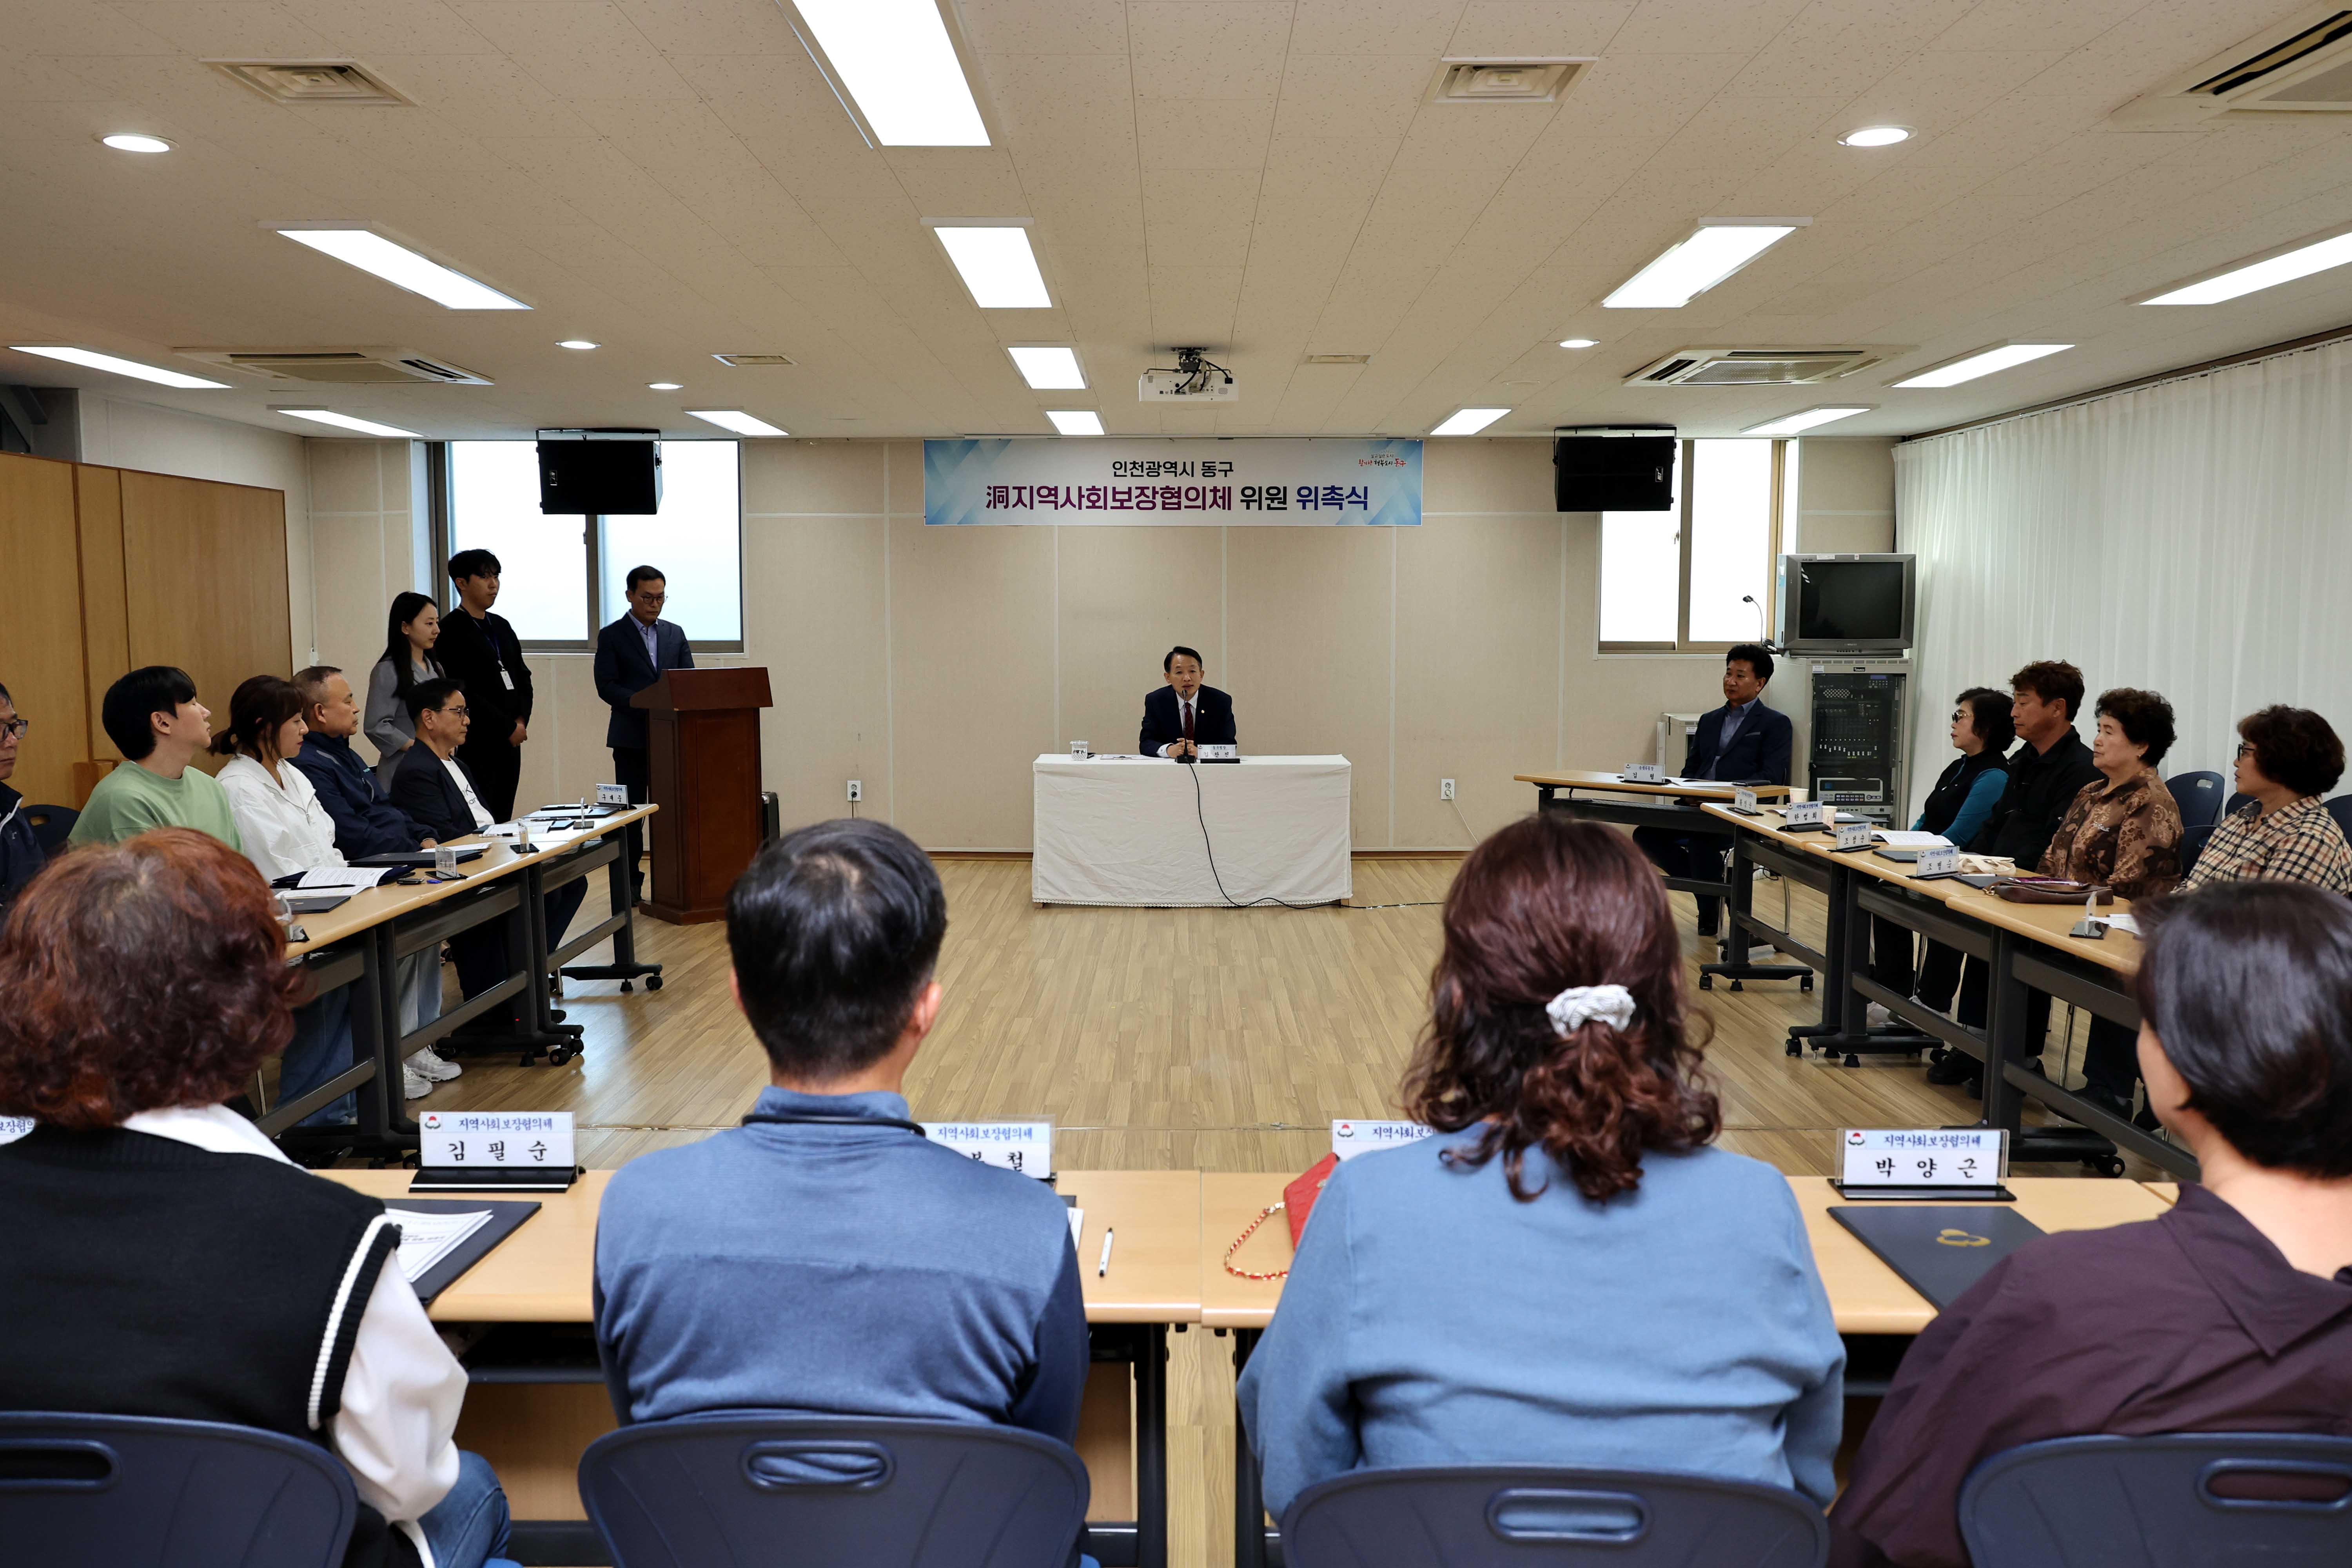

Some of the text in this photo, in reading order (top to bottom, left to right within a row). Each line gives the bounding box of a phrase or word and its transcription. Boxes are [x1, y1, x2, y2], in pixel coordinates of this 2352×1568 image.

[1112, 461, 1234, 477] 인천광역시 동구
[1394, 458, 1406, 467] 동구
[986, 485, 1368, 511] 洞지역사회보장협의체 위원 위촉식
[459, 1118, 552, 1131] 지역사회보장협의체
[938, 1127, 1033, 1140] 지역사회보장협의체
[1885, 1134, 1981, 1148] 지역사회보장협의체
